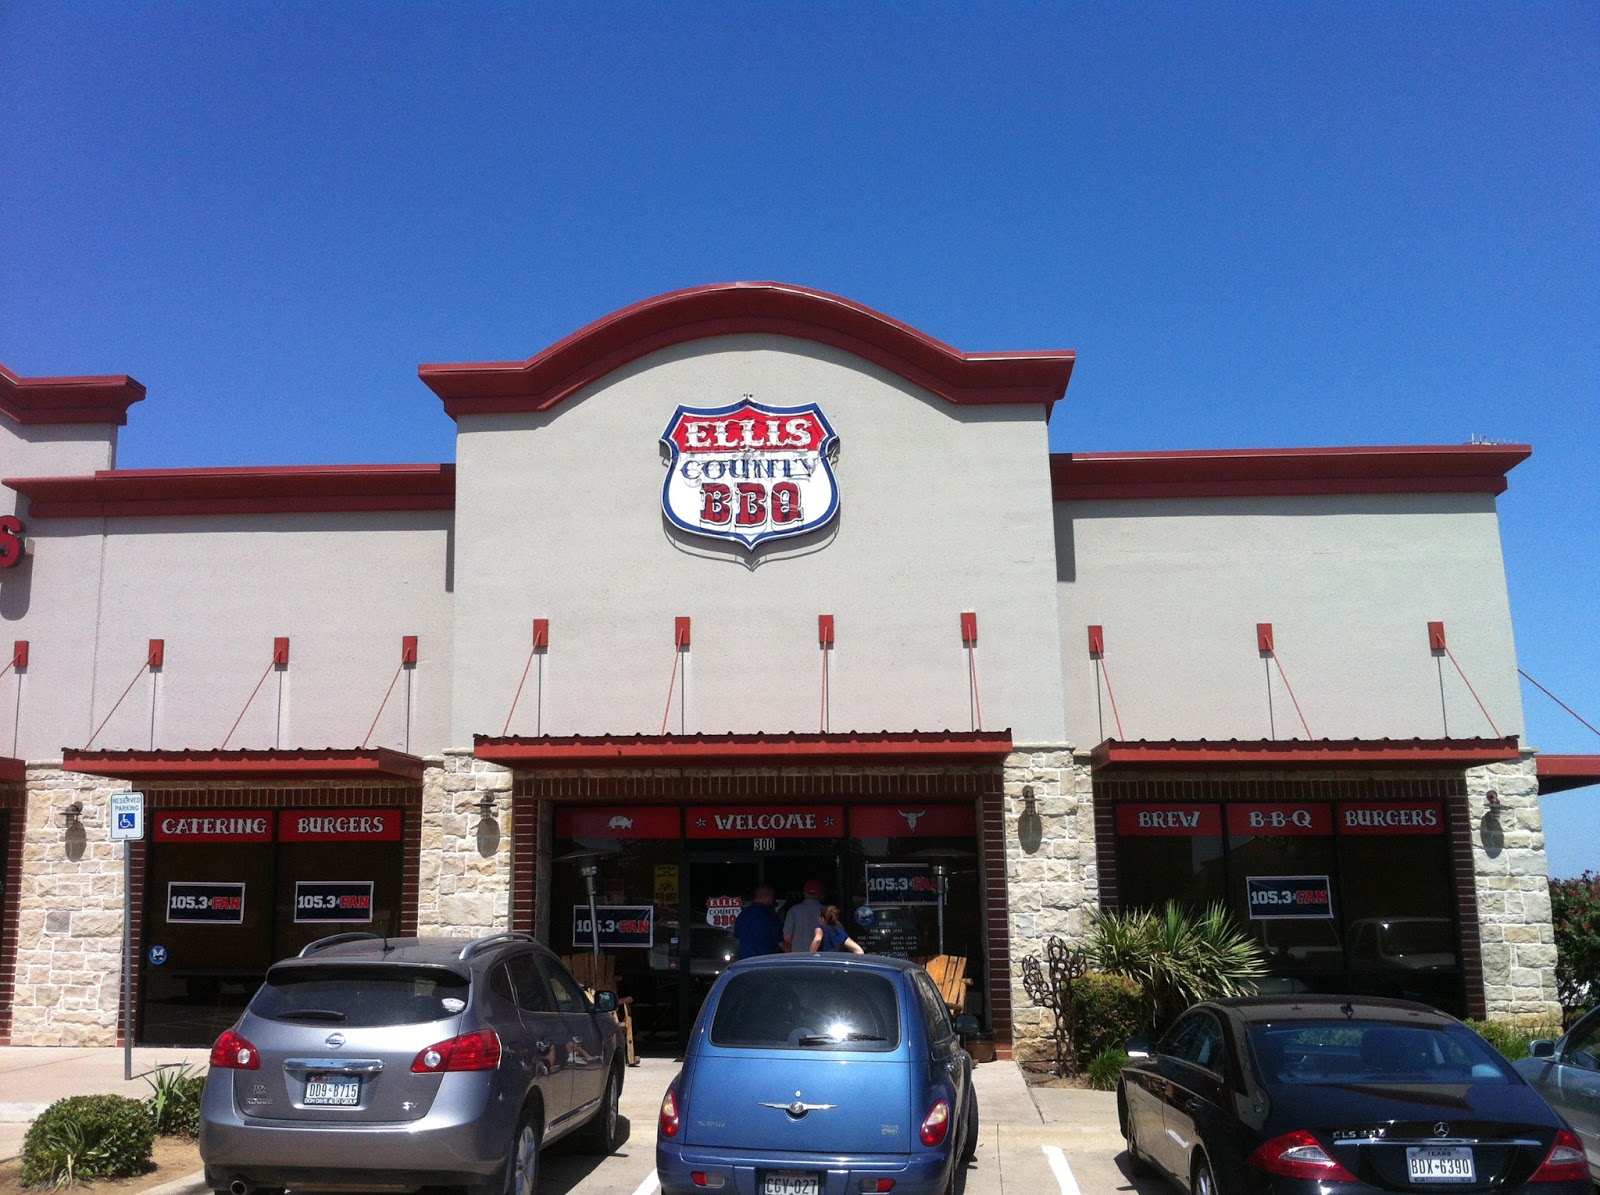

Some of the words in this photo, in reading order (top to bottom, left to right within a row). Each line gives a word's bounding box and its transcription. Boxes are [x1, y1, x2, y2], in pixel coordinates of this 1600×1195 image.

[684, 418, 813, 448] ELLIS
[680, 457, 819, 481] COUNTY
[699, 481, 804, 528] BBQ
[112, 796, 141, 804] RESERVED
[161, 818, 267, 835] CATERING
[297, 816, 385, 834] BURGERS
[714, 813, 817, 830] WELCOME
[1138, 810, 1201, 829] BREW
[1249, 810, 1313, 829] B-B-Q
[1345, 809, 1437, 828] BURGERS
[754, 838, 776, 850] 300
[869, 877, 909, 891] 105.3
[170, 895, 208, 909] 105.3
[212, 896, 241, 910] FAN
[297, 895, 336, 909] 105.3
[340, 895, 370, 909] FAN
[710, 898, 740, 907] ELLIS
[1251, 890, 1292, 905] 105.3
[1296, 889, 1328, 905] FAN
[620, 919, 650, 934] FAN
[1332, 1130, 1356, 1138] CLS
